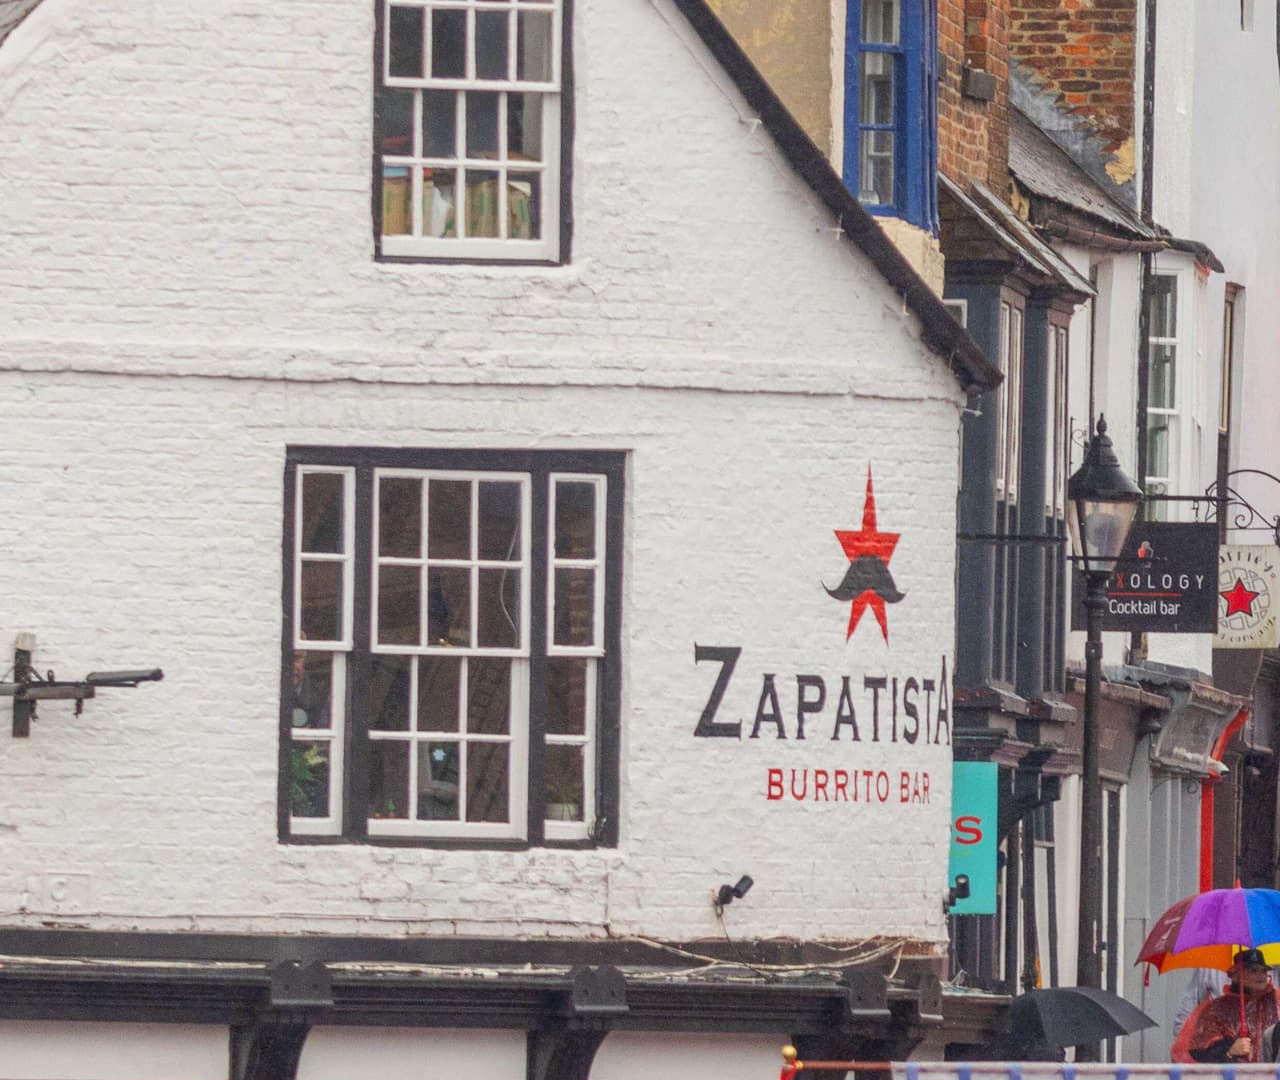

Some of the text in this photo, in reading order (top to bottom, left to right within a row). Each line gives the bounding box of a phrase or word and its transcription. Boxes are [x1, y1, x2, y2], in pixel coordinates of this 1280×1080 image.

[1106, 574, 1204, 590] XOLOGY
[1109, 599, 1180, 616] Cocktail bar
[694, 642, 951, 746] ZAPATISTA
[768, 768, 930, 804] BURRITO BAR
